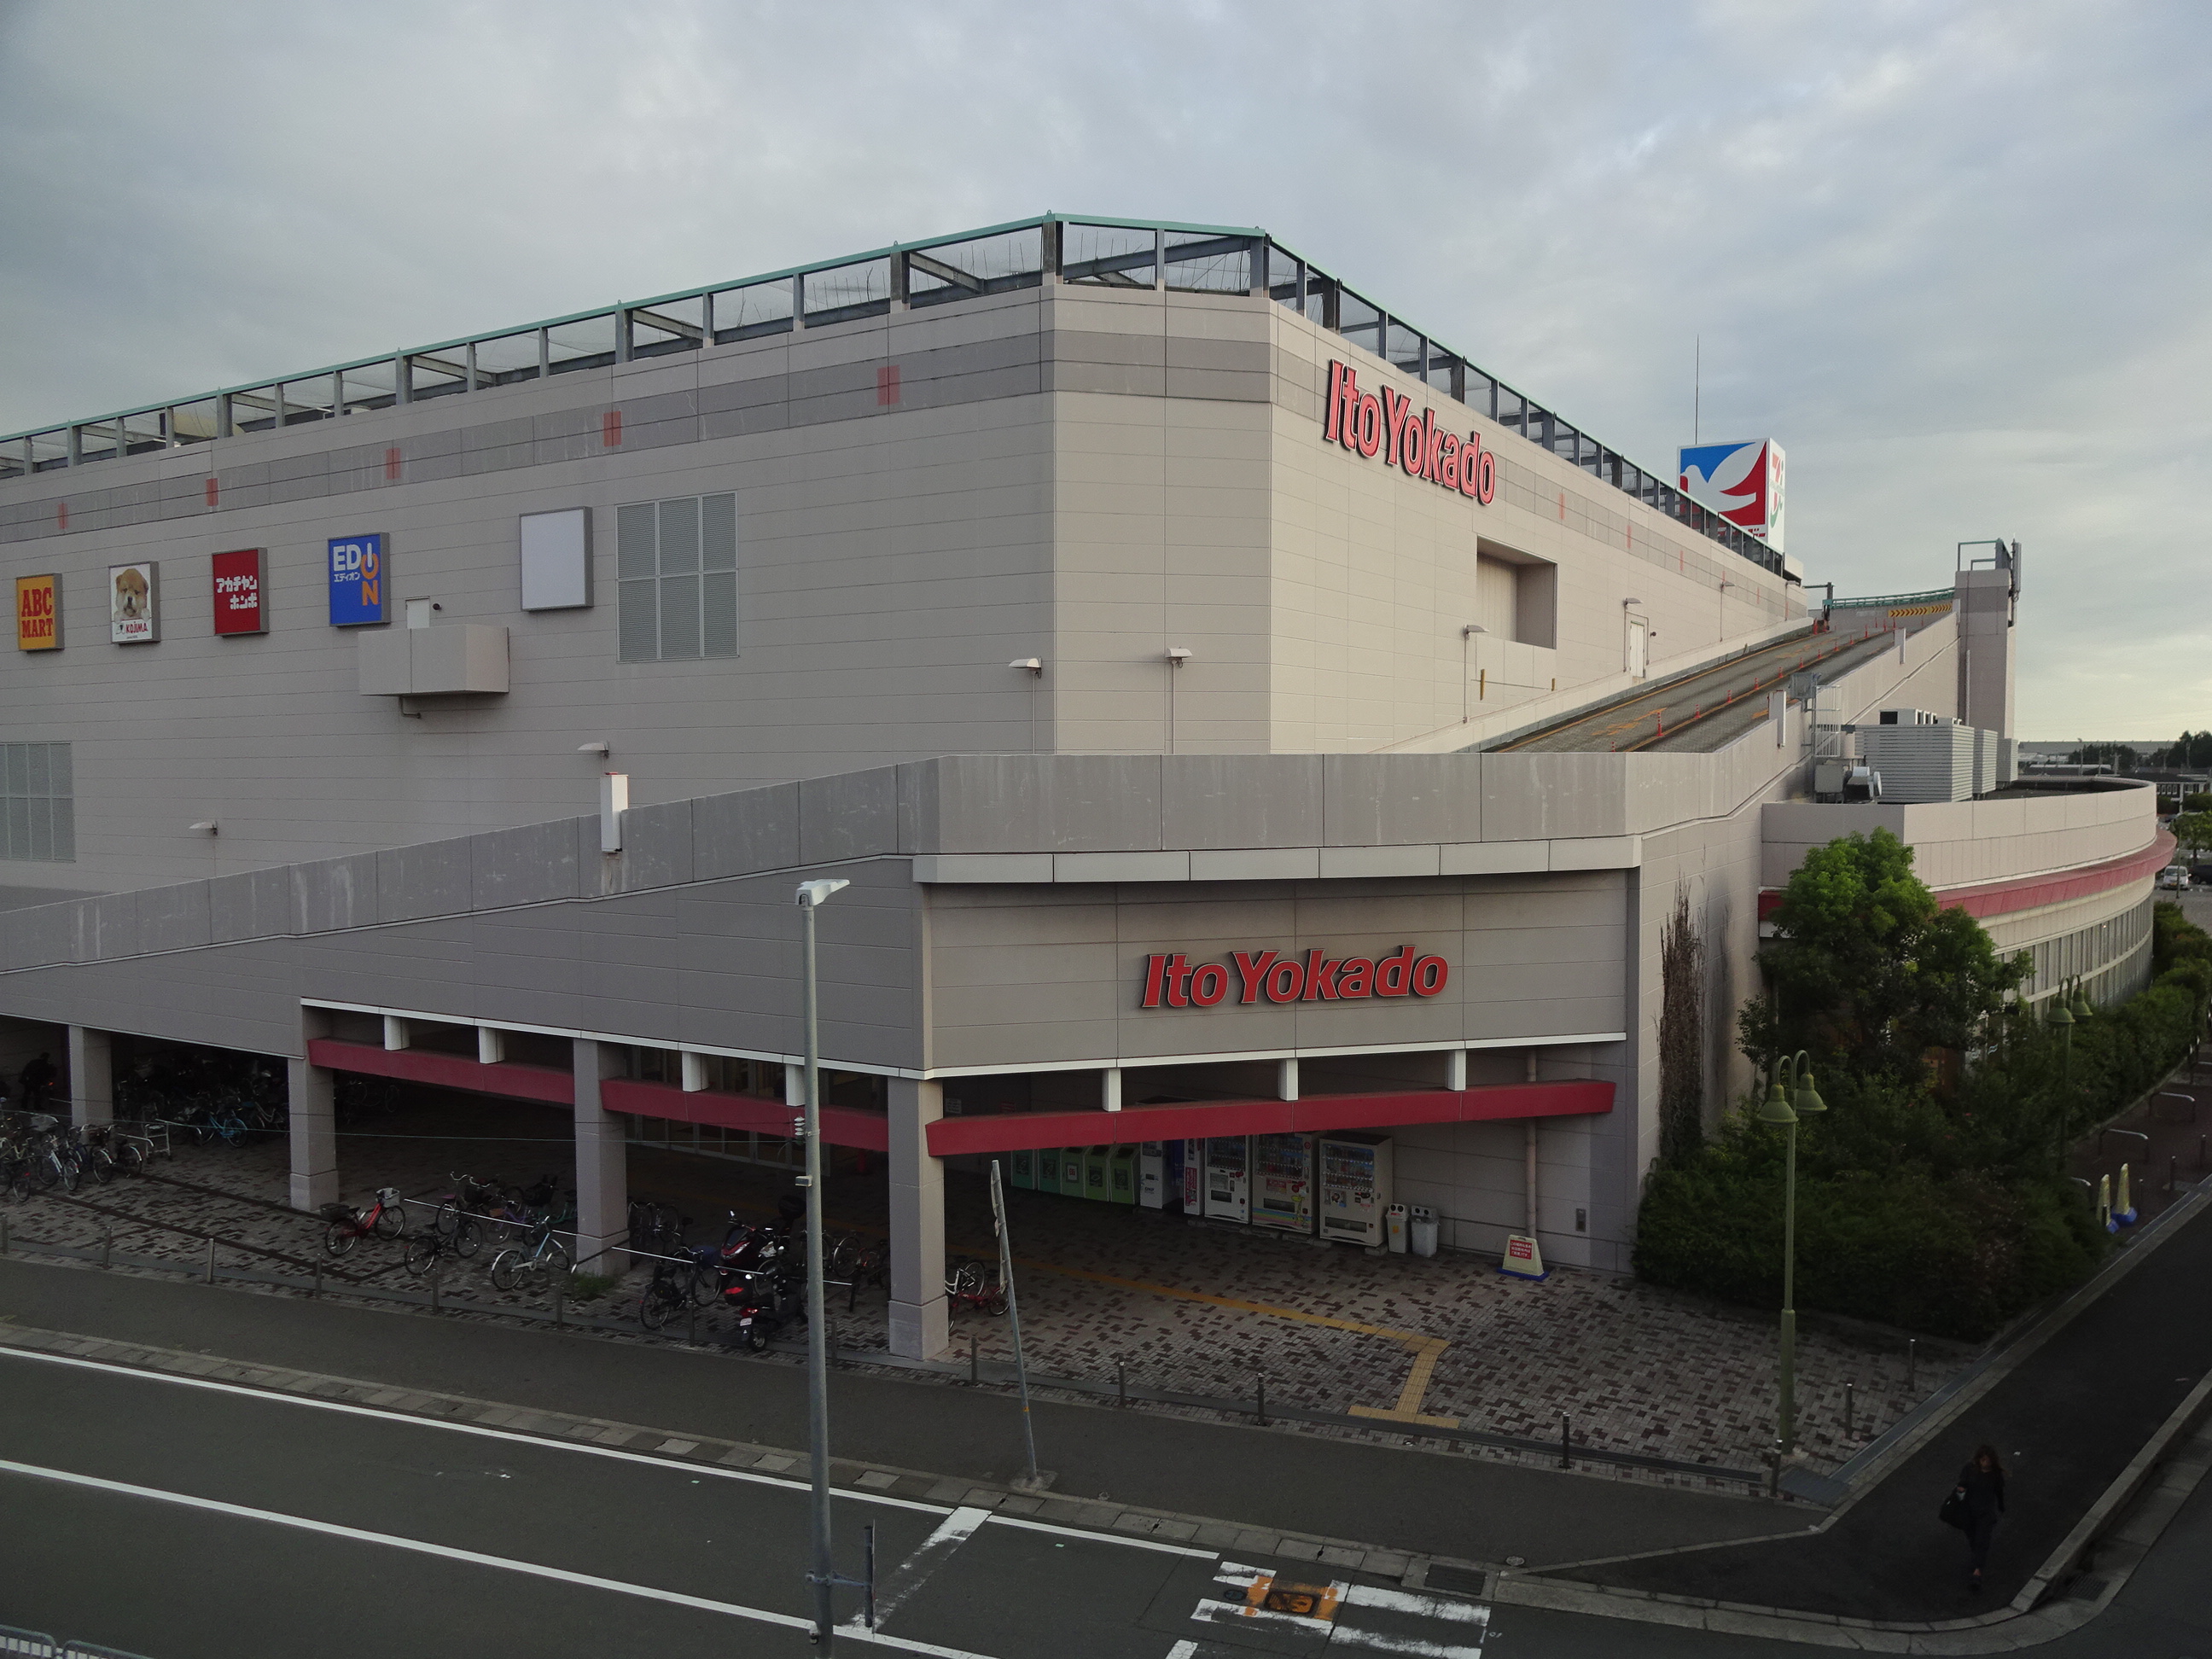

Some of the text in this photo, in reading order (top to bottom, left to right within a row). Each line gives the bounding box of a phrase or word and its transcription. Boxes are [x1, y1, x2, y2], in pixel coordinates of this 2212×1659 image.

[334, 571, 360, 583] エディオン
[21, 586, 52, 617] ABC
[22, 618, 53, 638] MART
[1141, 944, 1449, 1008] Ito Yokado
